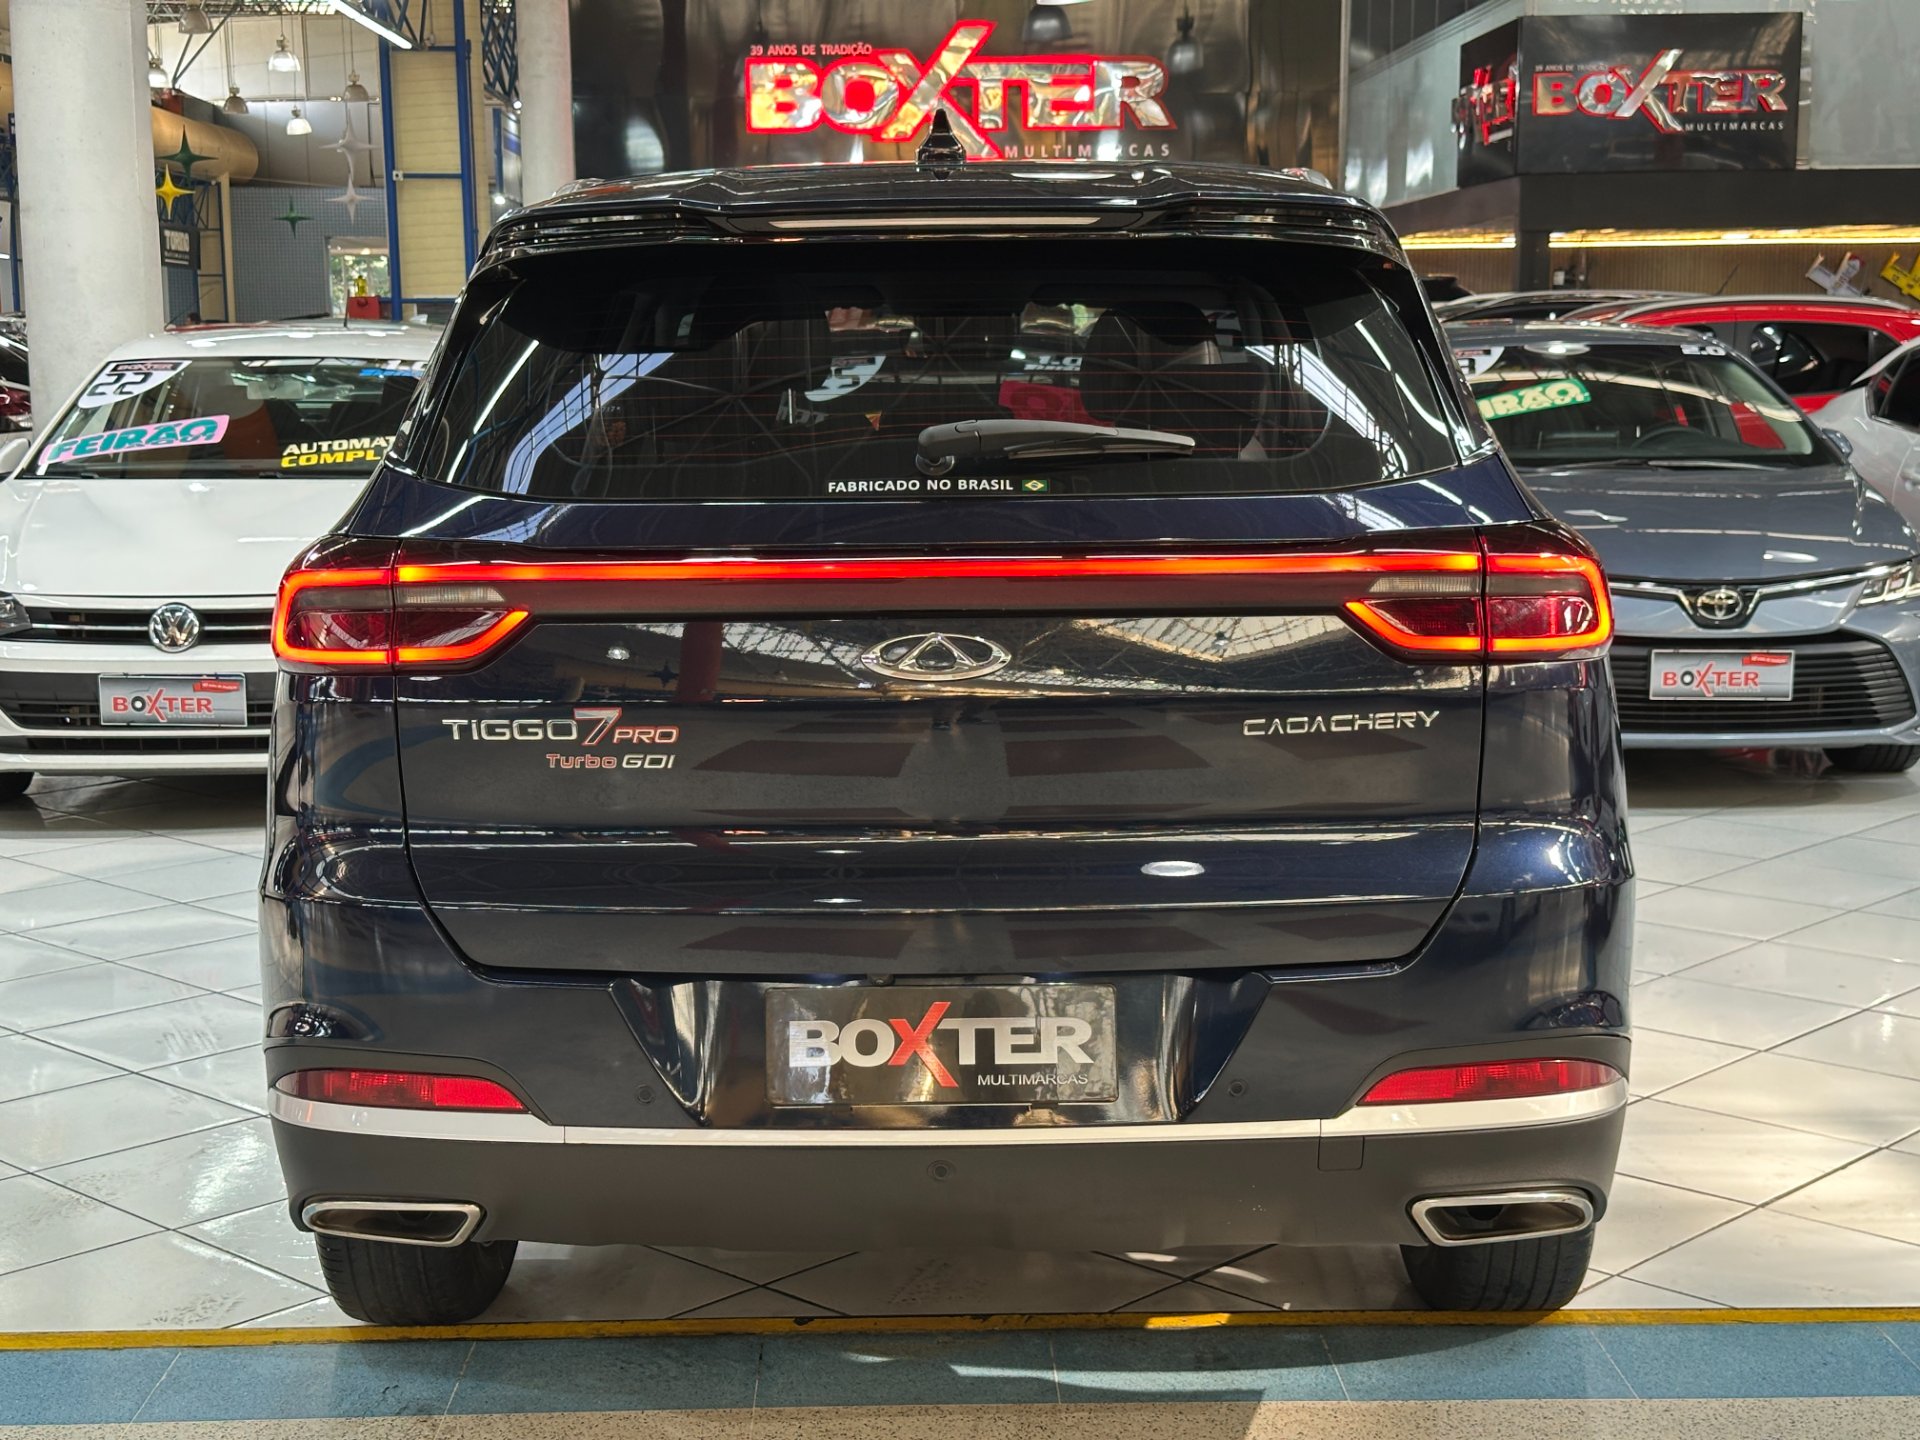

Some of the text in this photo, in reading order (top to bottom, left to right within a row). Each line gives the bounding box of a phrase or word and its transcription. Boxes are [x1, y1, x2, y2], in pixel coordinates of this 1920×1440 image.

[750, 42, 872, 56] 39 ANOS DE TRADIÇÃO
[746, 20, 1177, 159] BOXTER
[1532, 49, 1788, 134] BOXTER
[1685, 121, 1784, 132] MULTIMARCAS
[1004, 144, 1170, 159] MULTIMCAS
[86, 372, 154, 396] 22
[47, 419, 218, 461] FEIRÃO
[828, 479, 1014, 493] FABRICADO NO BRASIL
[1661, 660, 1760, 697] BOXTER
[111, 687, 214, 723] BOXTER
[613, 726, 679, 744] PRO
[546, 753, 676, 769] Turbo GDI
[788, 1001, 1095, 1088] BOXTER
[977, 1073, 1090, 1086] MULTIMARCAS
